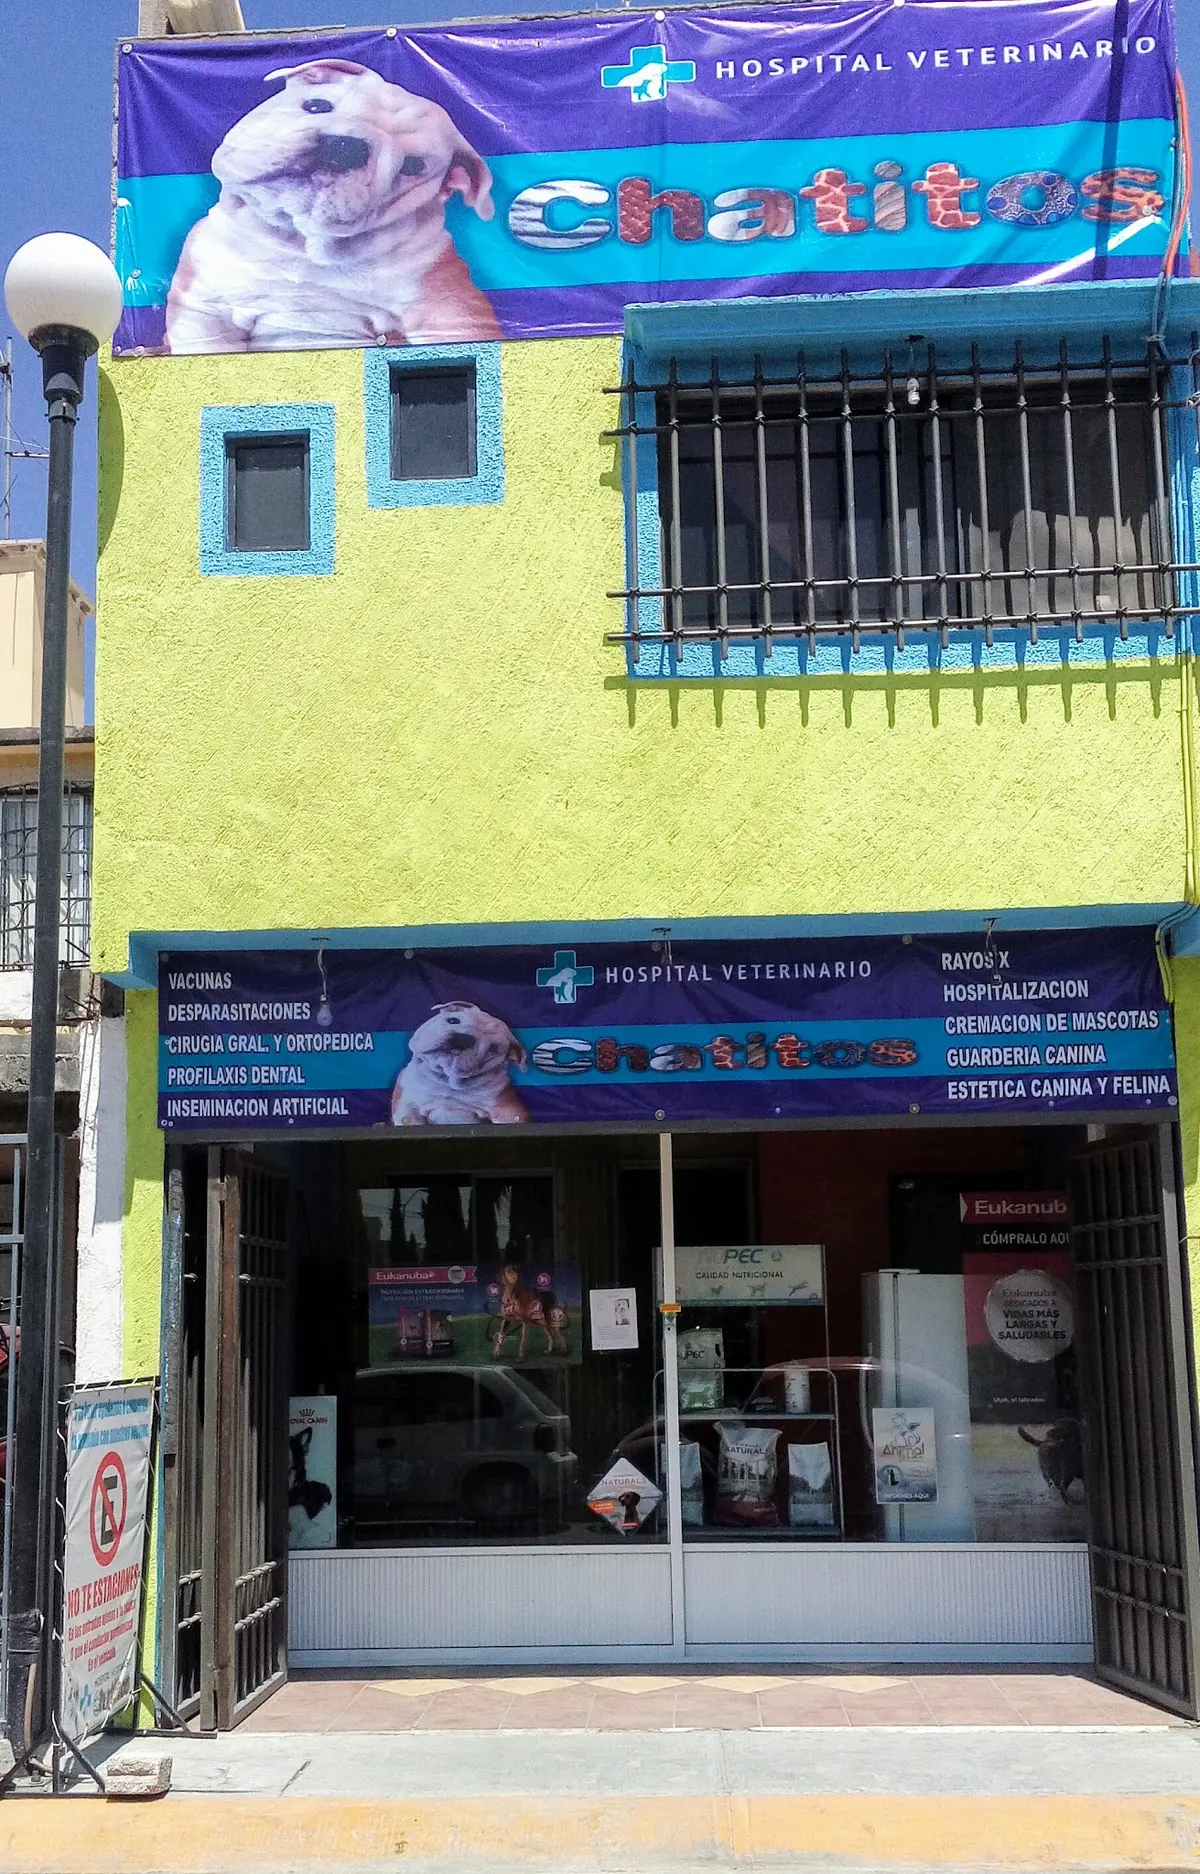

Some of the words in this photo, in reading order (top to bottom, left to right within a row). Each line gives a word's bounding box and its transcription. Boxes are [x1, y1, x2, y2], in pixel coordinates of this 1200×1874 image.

[715, 50, 892, 80] HOSPITAL
[907, 35, 1157, 71] VETERINARIO
[507, 160, 1164, 251] Chatitos
[941, 951, 994, 971] RAYOS
[998, 951, 1010, 969] X
[168, 972, 232, 991] VACUNAS
[605, 965, 712, 984] HOSPITAL
[723, 961, 872, 981] VETERINARIO
[943, 980, 1089, 1003] HOSPITALIZACION
[168, 1002, 311, 1023] DESPARASITACIONES
[944, 1012, 1042, 1035] CREMACION
[1045, 1011, 1068, 1032] DE
[1072, 1009, 1160, 1032] MASCOTAS
[168, 1033, 224, 1054] CIRUGIA
[228, 1033, 270, 1054] GRAL.
[273, 1033, 284, 1053] Y
[286, 1032, 375, 1053] ORTOPEDICA
[531, 1031, 919, 1076] Chatitos
[946, 1046, 1041, 1068] GUARDERIA
[1044, 1044, 1107, 1066] CANINA
[168, 1065, 248, 1086] PROFILAXIS
[252, 1064, 306, 1085] DENTAL
[947, 1079, 1027, 1101] ESTETICA
[1030, 1078, 1094, 1098] CANINA
[1096, 1077, 1110, 1096] Y
[1113, 1074, 1171, 1096] FELINA
[167, 1097, 269, 1118] INSEMINACION
[272, 1095, 349, 1117] ARTIFICIAL
[974, 1199, 1068, 1216] Eukanub
[983, 1229, 1048, 1245] CÓMPRALO
[376, 1271, 429, 1281] Eukanuba
[695, 1271, 729, 1280] CALIDAD
[732, 1270, 784, 1279] NUTRICIONAL
[1002, 1310, 1035, 1319] VIDAS
[1037, 1308, 1060, 1319] MÁS
[1006, 1320, 1048, 1329] LARGAS
[1050, 1320, 1057, 1328] Y
[998, 1331, 1066, 1340] SALUDABLES
[289, 1417, 305, 1425] OYAL
[68, 1588, 80, 1619] NO
[82, 1583, 92, 1614] TE
[93, 1563, 139, 1609] ESTACIONES
